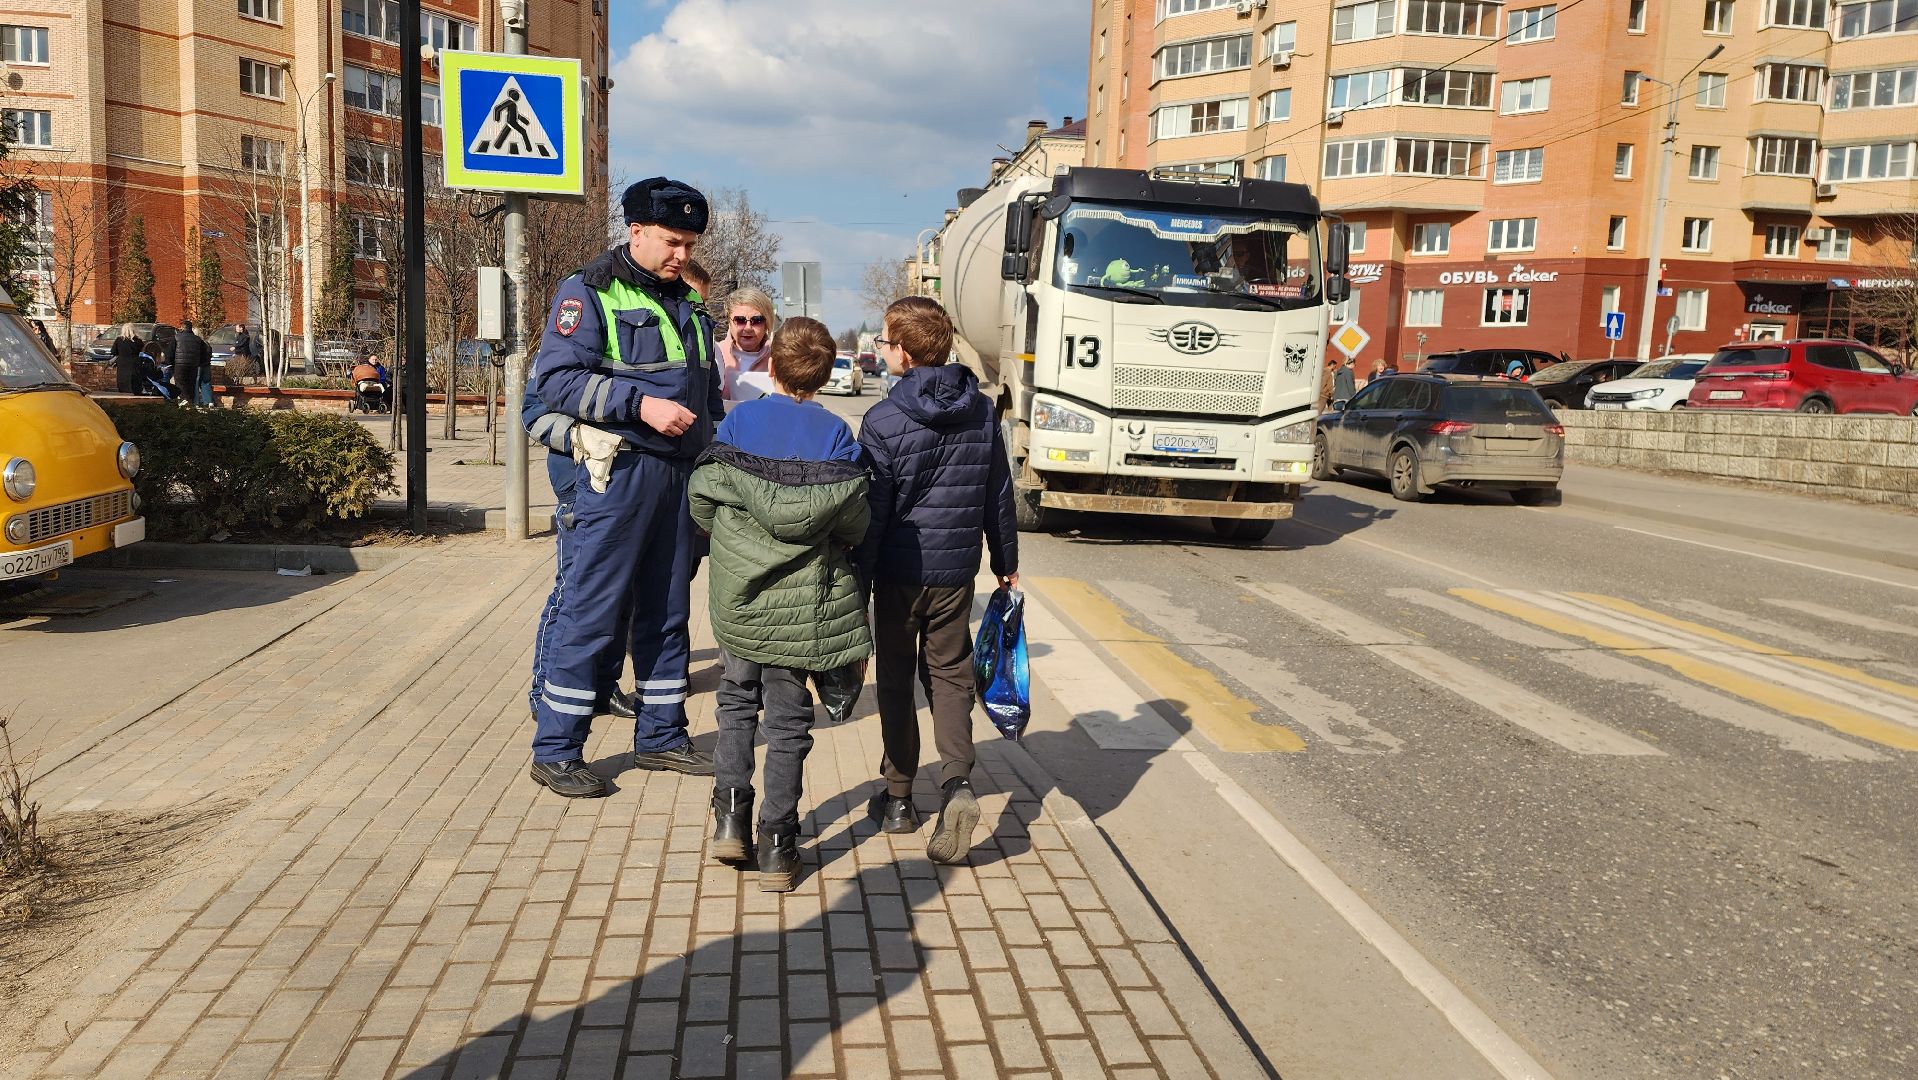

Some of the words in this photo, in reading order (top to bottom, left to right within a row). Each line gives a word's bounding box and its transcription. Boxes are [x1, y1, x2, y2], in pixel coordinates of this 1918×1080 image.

[1170, 218, 1203, 229] MERCEDES
[1439, 271, 1499, 284] ОБУВЬ
[1507, 264, 1559, 283] rieker
[1748, 295, 1793, 314] rieker
[1064, 334, 1101, 369] 13
